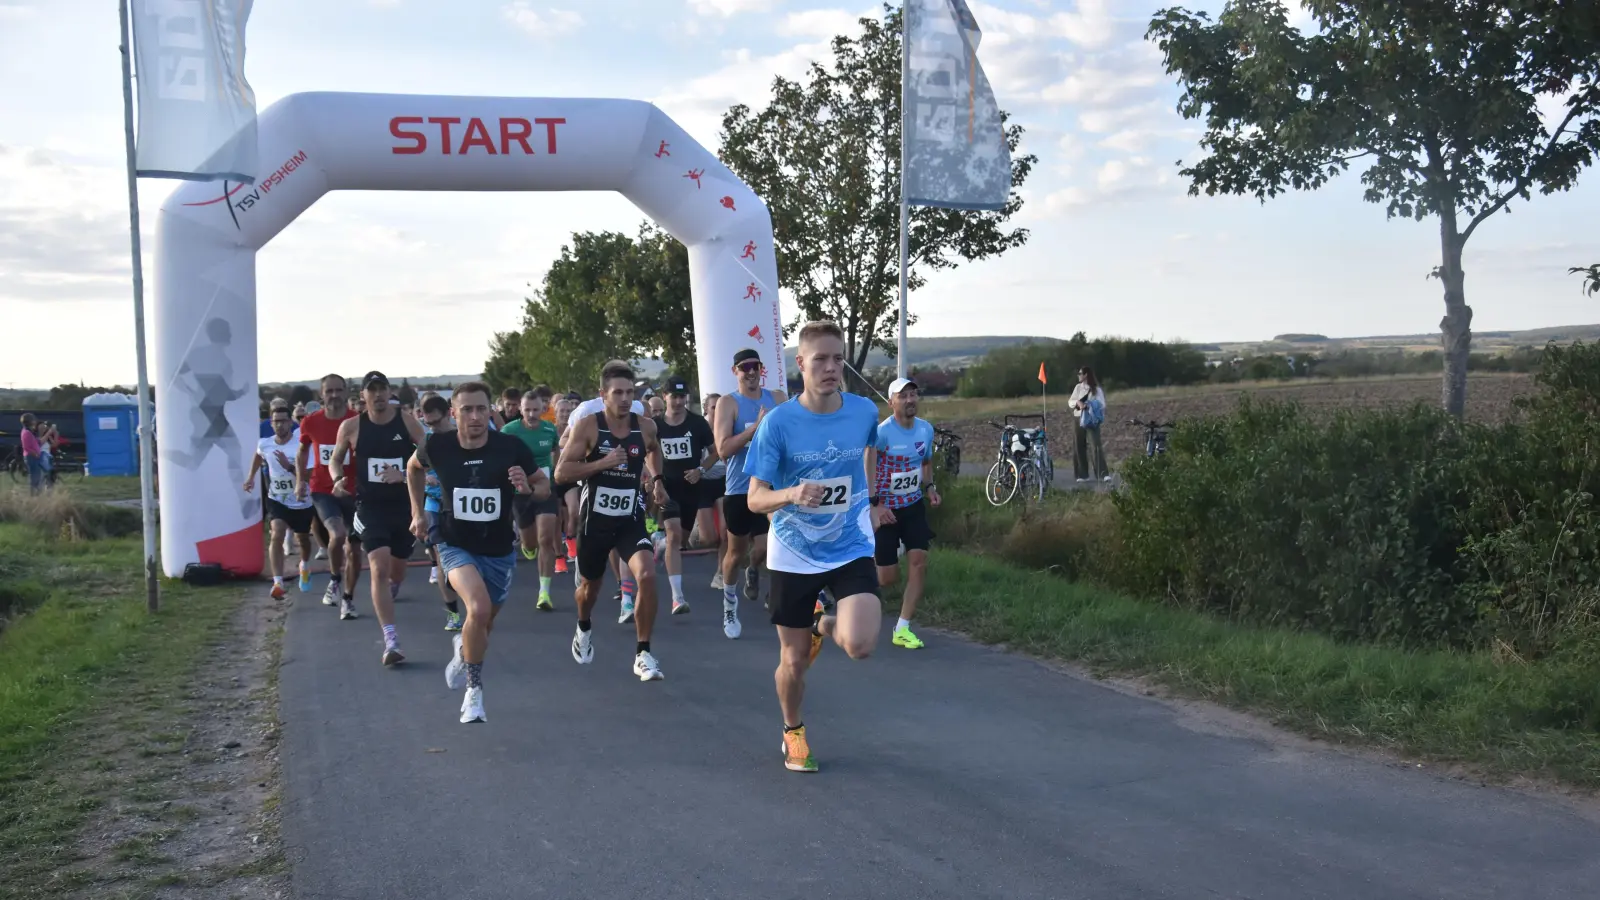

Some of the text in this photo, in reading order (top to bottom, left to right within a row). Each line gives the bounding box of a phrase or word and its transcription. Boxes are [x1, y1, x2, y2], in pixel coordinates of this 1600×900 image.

[389, 116, 566, 155] START
[235, 150, 308, 212] TSV IPSHEIM
[664, 441, 689, 455] 319
[836, 447, 864, 458] center
[274, 478, 294, 490] 361
[893, 474, 919, 490] 234
[458, 495, 496, 514] 106
[598, 492, 631, 511] 396
[819, 484, 847, 506] 22
